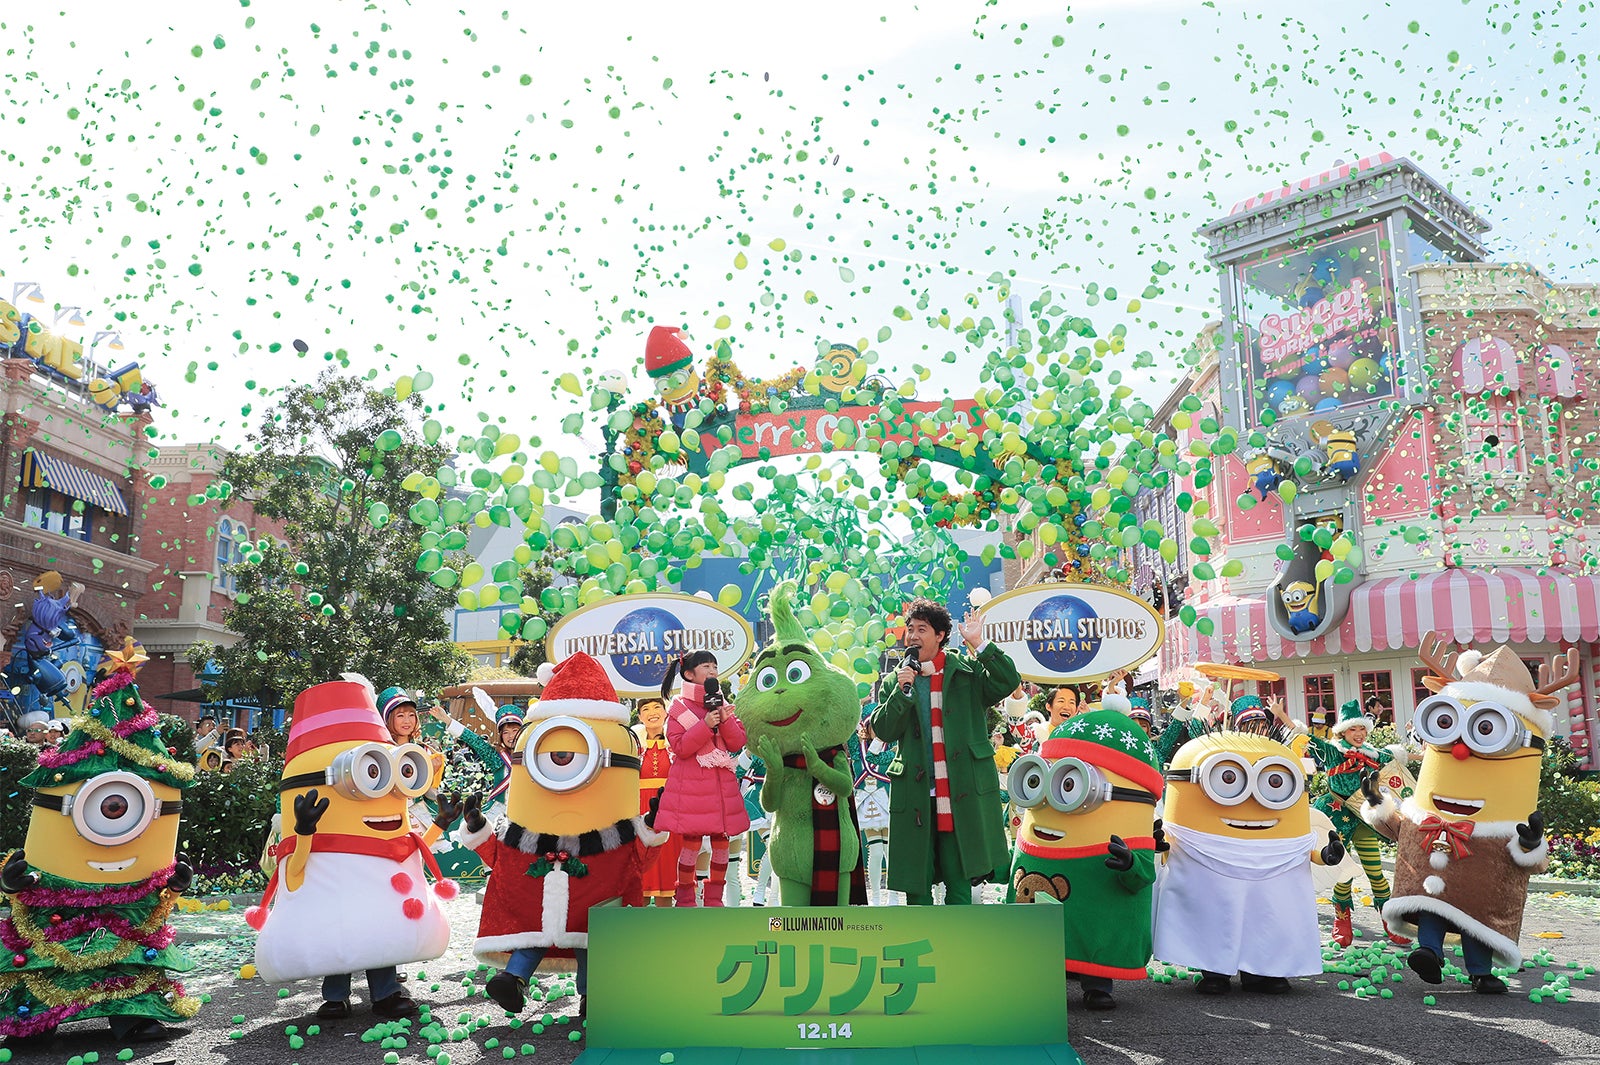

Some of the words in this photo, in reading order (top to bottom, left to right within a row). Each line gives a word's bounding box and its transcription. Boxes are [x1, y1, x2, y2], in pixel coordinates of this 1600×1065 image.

[1260, 277, 1367, 348] Sweet
[1263, 353, 1316, 378] CANDIS
[1329, 328, 1378, 353] TRETS
[816, 406, 983, 447] Cristmas
[565, 630, 658, 658] UNIVERSAL
[663, 629, 735, 651] STUDIOS
[982, 619, 1073, 643] UNIVERSAL
[1078, 618, 1147, 640] STUDIOS
[622, 652, 680, 667] JAPAN
[1038, 641, 1092, 653] JAPAN
[783, 917, 844, 931] ILLUMINATION
[716, 939, 936, 1016] グリンチ
[797, 1022, 853, 1039] 12.14
